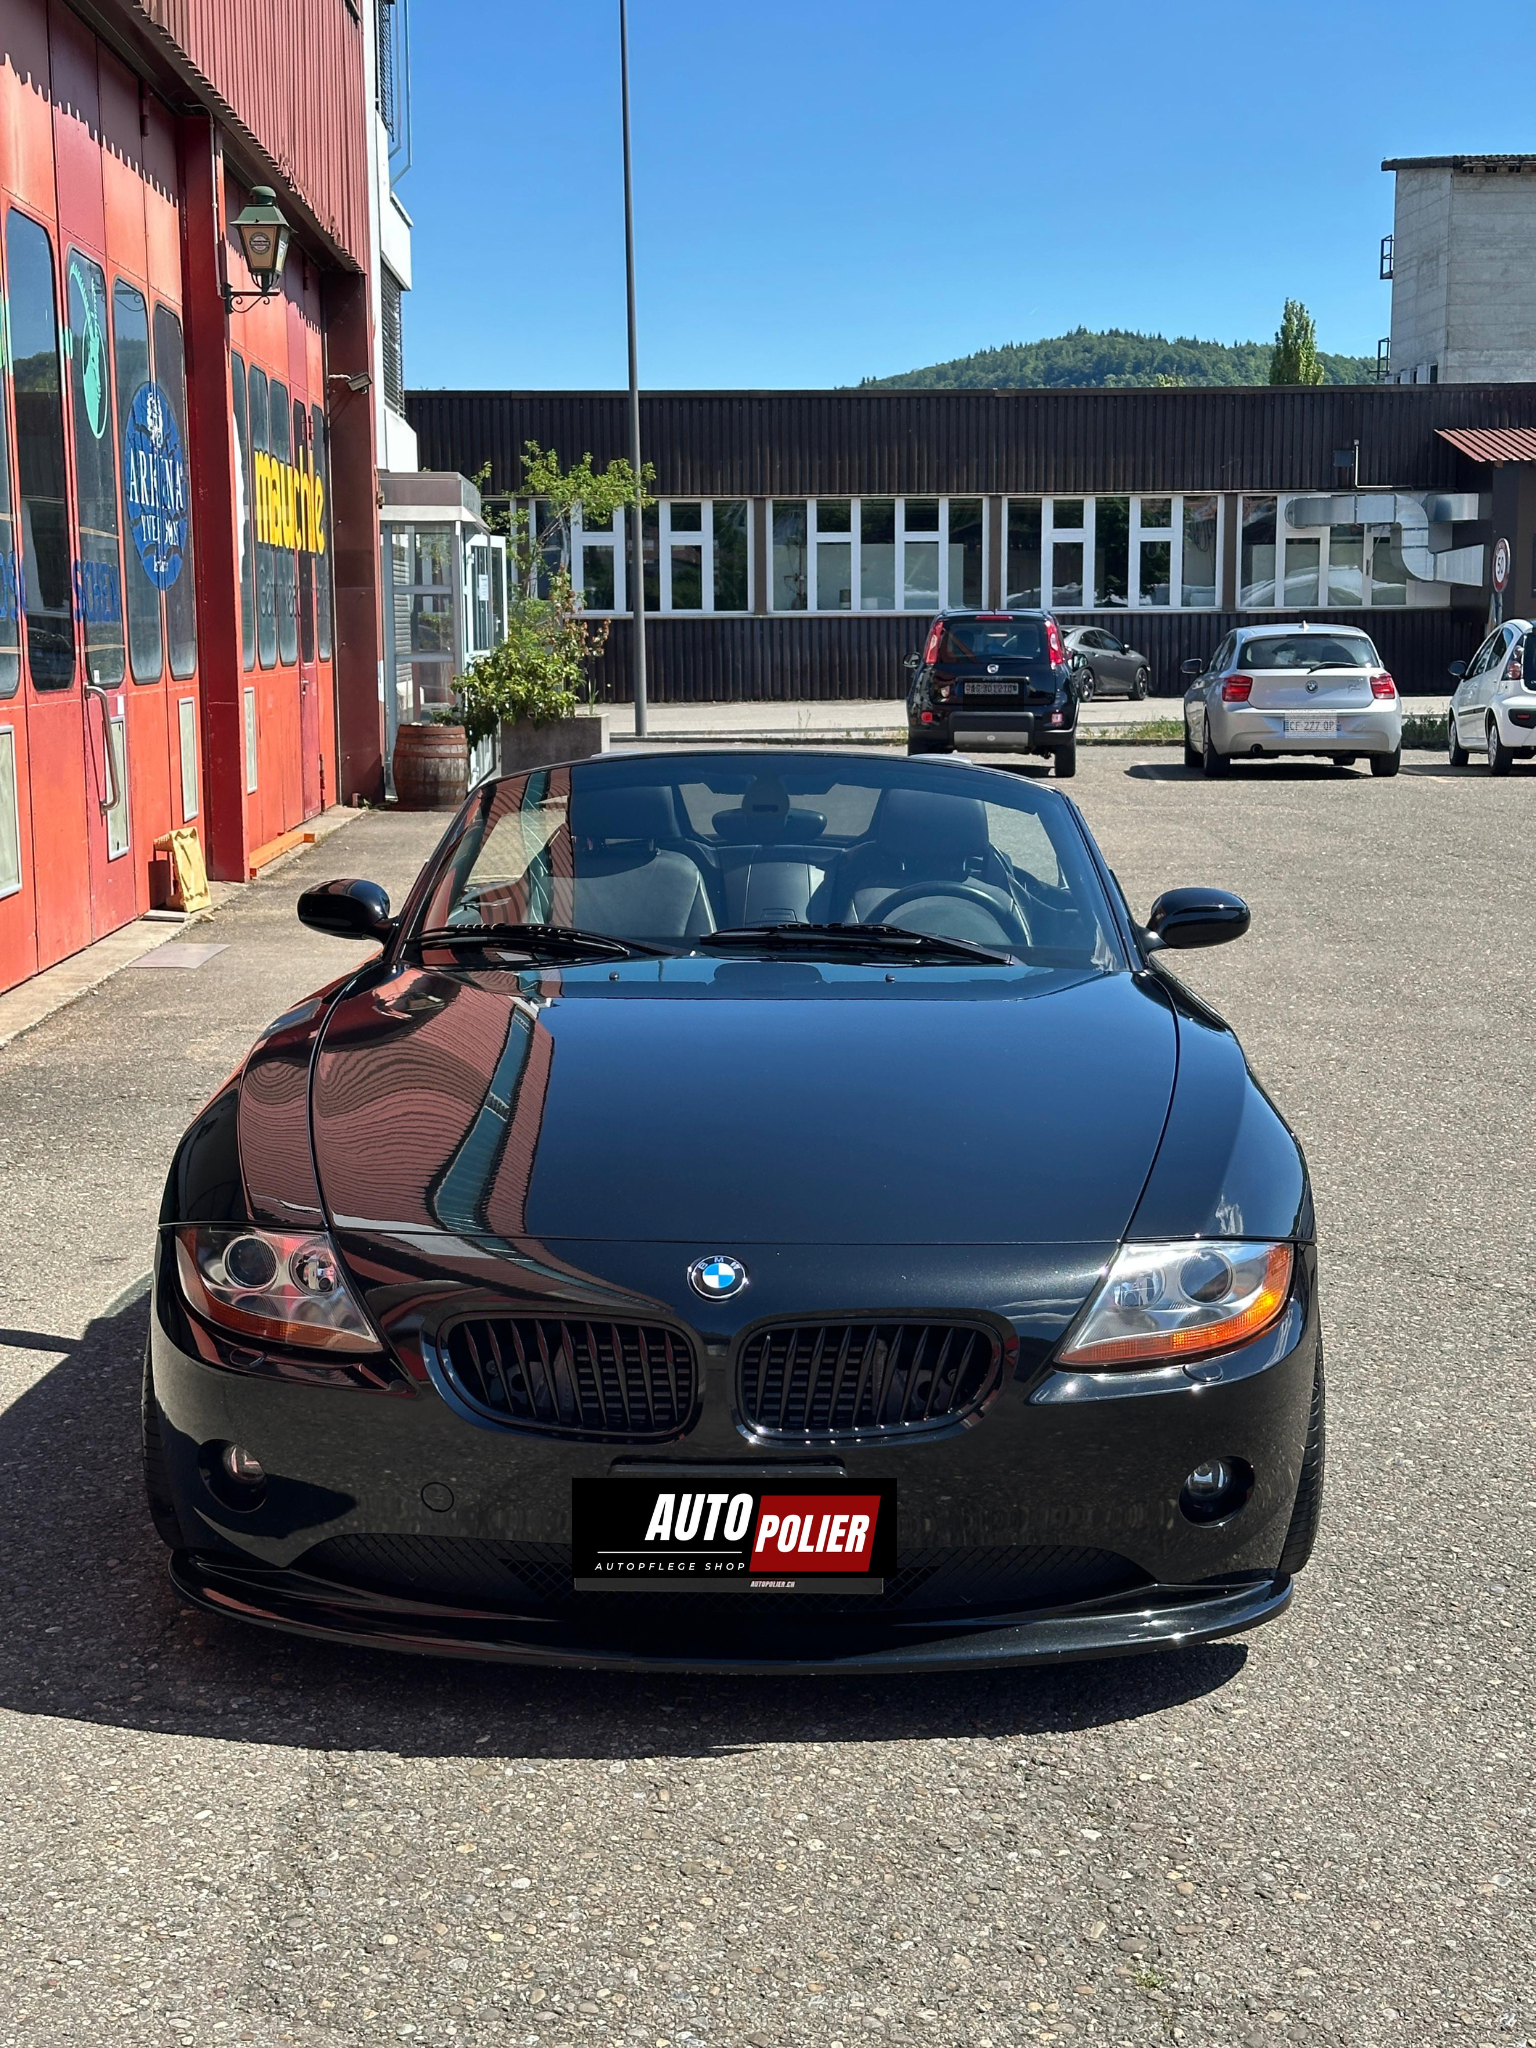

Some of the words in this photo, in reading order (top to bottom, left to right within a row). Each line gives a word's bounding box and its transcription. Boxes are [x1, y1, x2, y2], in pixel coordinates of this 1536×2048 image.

[254, 444, 325, 555] mauchle
[698, 1257, 741, 1270] BMW
[750, 1580, 796, 1588] AUTOPOLIER.CH
